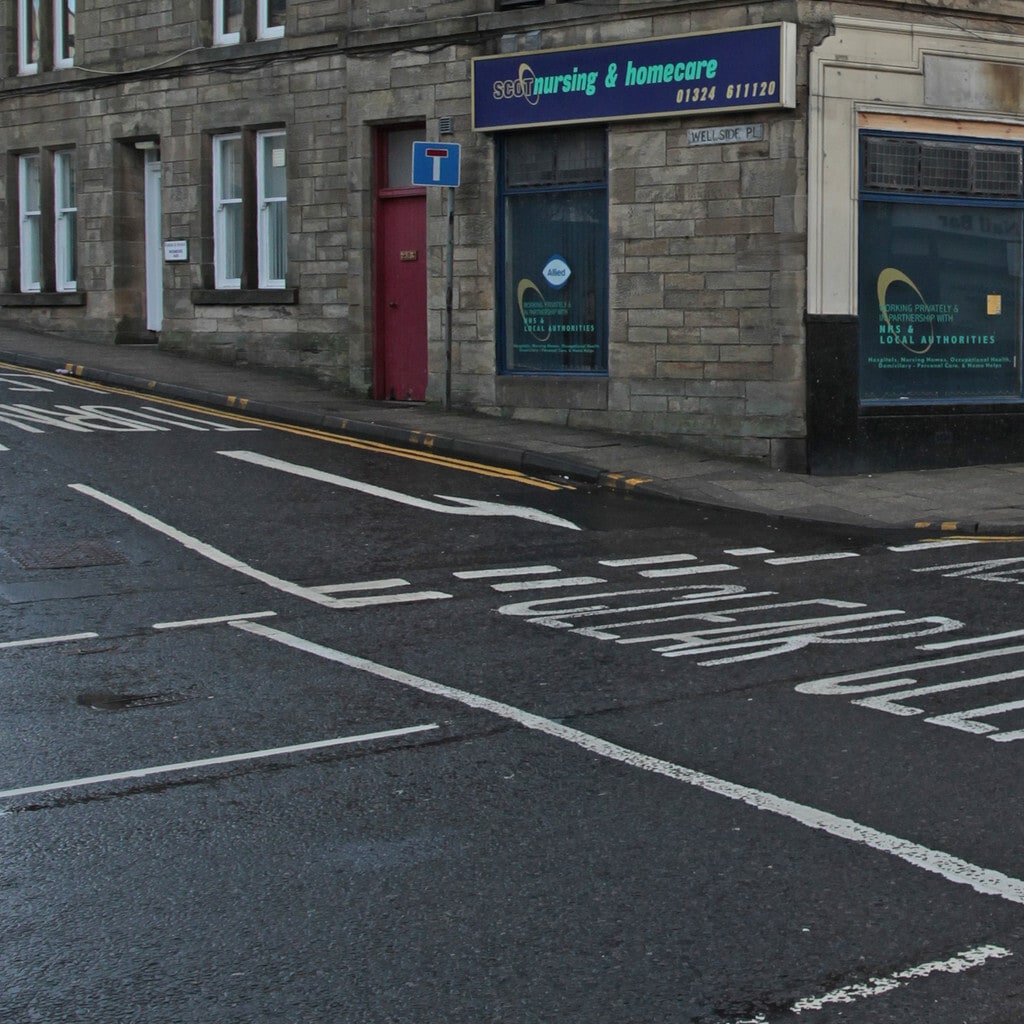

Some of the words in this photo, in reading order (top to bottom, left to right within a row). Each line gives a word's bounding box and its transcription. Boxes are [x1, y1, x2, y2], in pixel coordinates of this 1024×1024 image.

[605, 63, 618, 88] &
[625, 59, 718, 86] homecare
[676, 86, 716, 104] 01324
[726, 80, 776, 99] 611120
[691, 128, 740, 142] WELLSIDE
[746, 127, 761, 139] PL
[908, 325, 914, 334] &
[880, 336, 915, 344] LOCAL
[920, 336, 996, 344] AUTHORITIES
[498, 584, 966, 666] CLEAR
